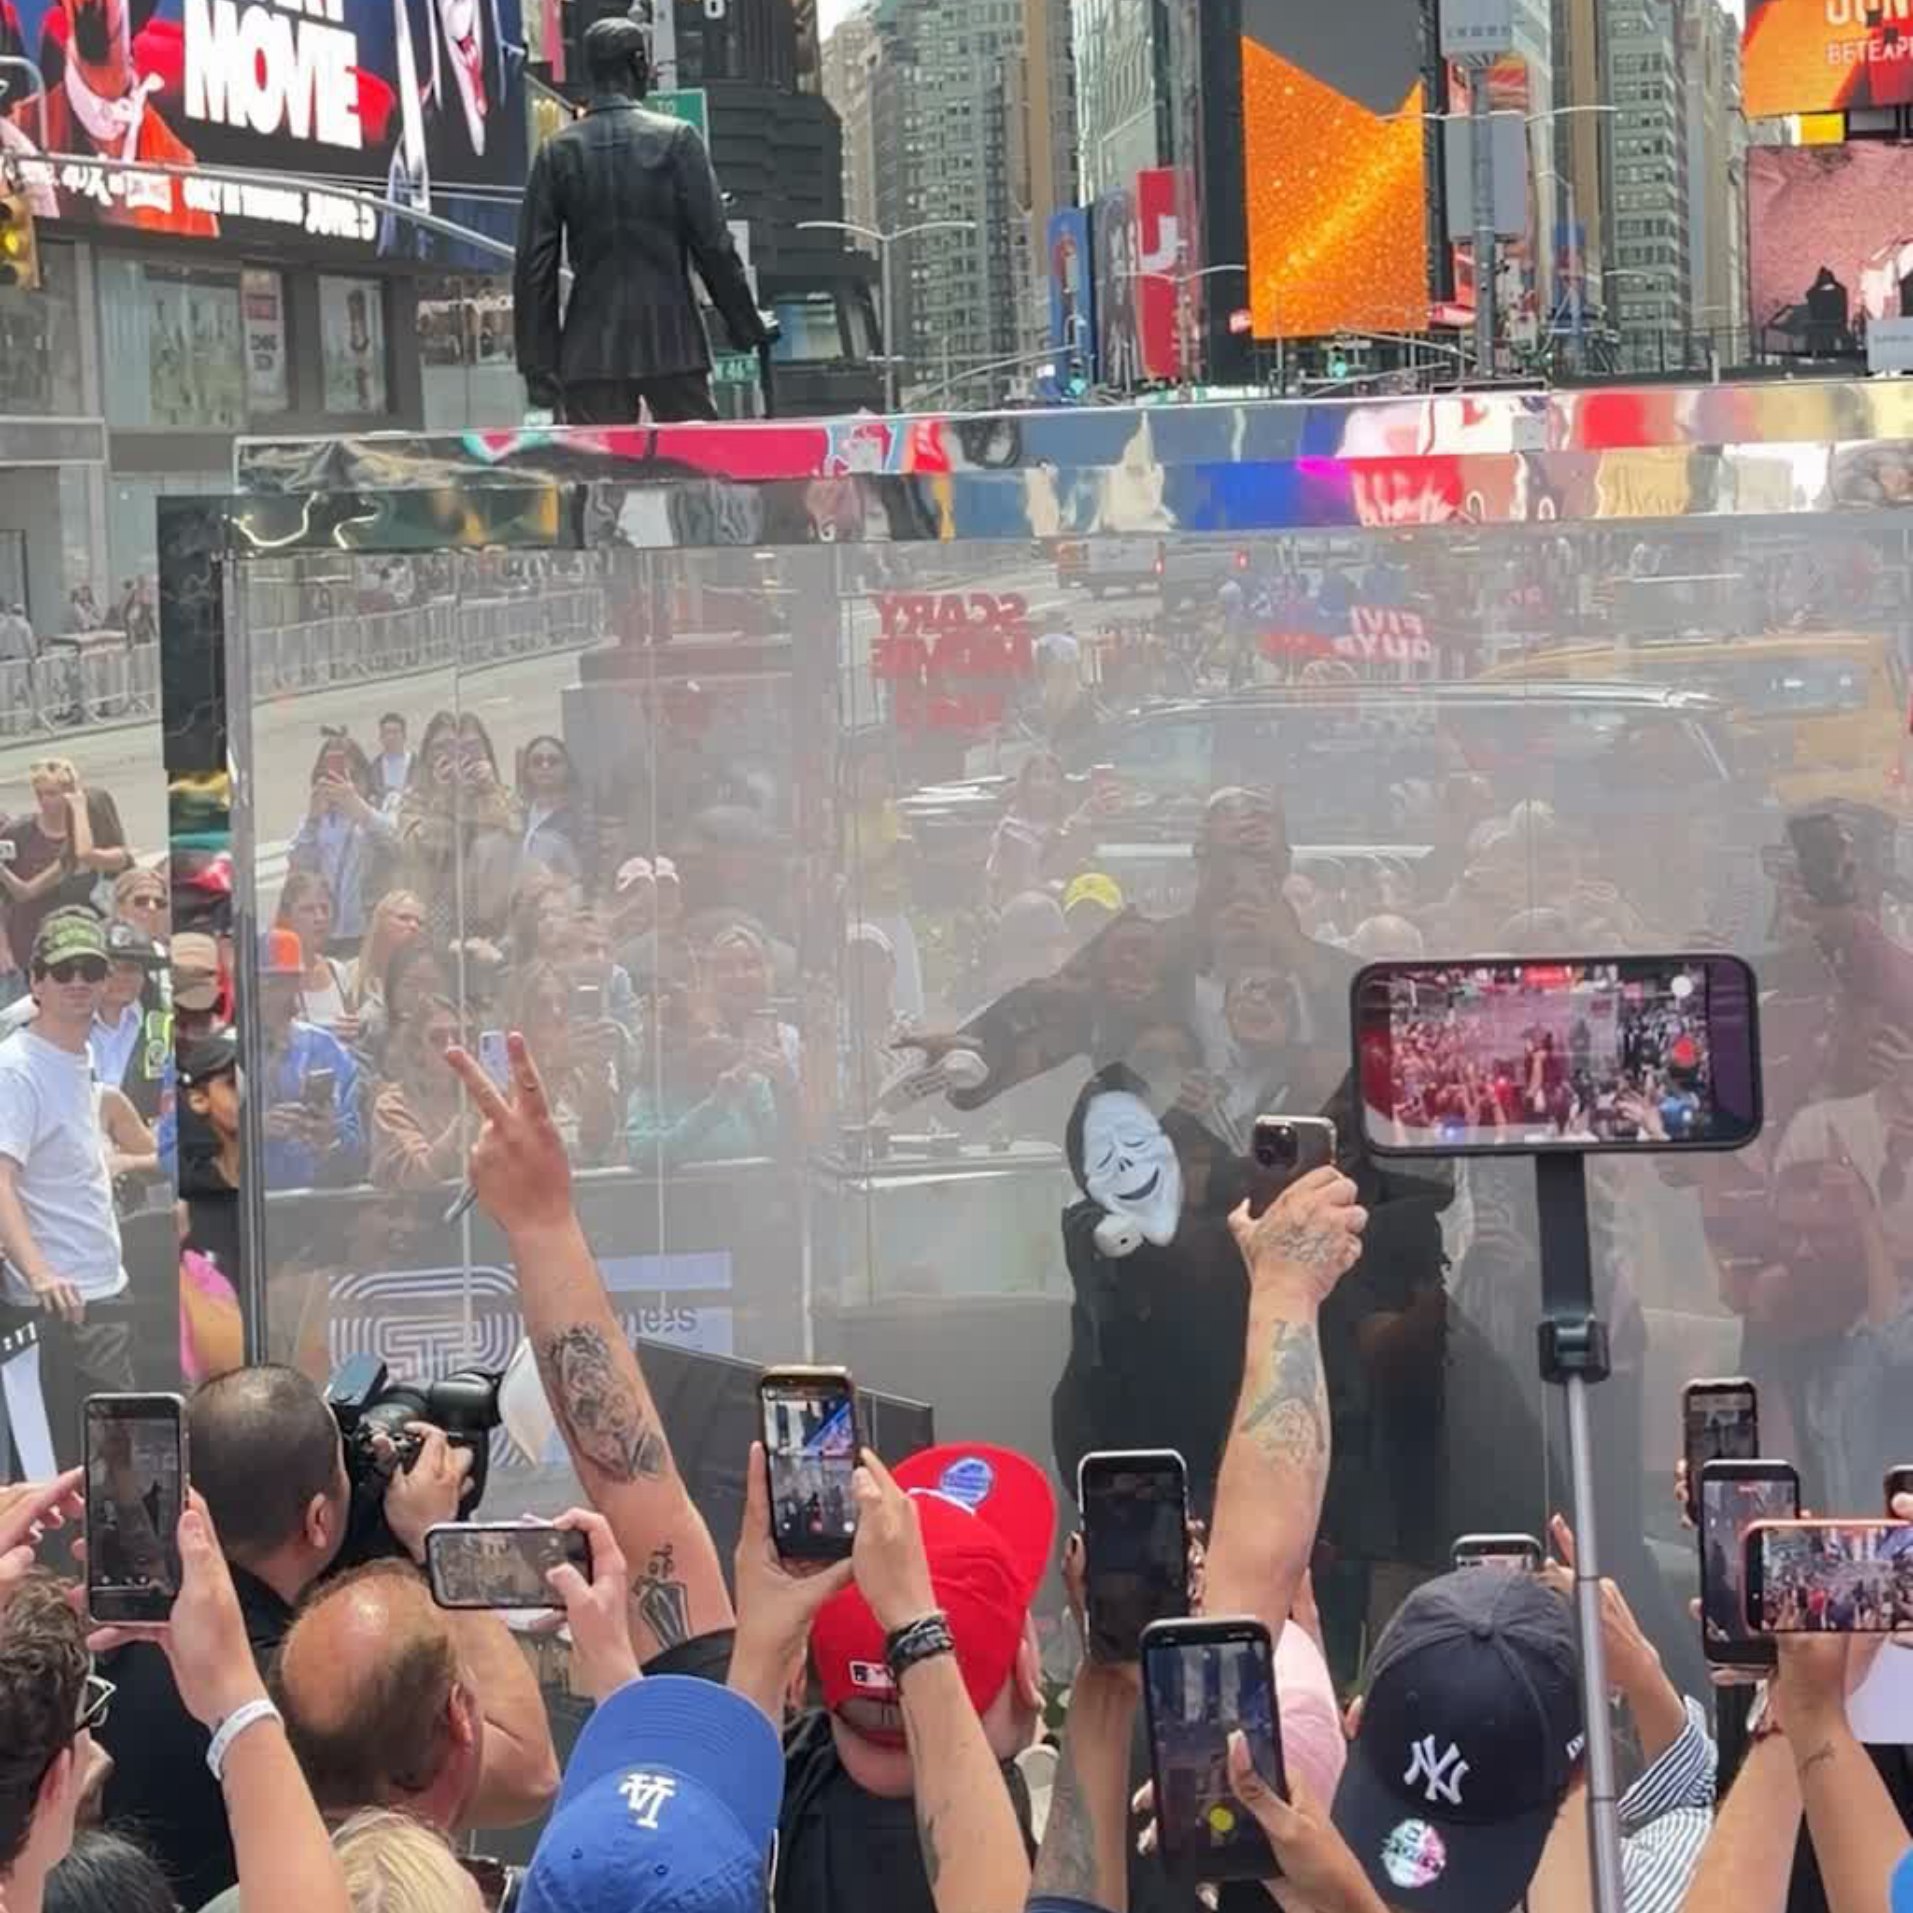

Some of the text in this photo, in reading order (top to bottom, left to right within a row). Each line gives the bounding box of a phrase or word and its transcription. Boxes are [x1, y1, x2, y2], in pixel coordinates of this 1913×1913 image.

[184, 0, 362, 150] MOVIE
[618, 1772, 676, 1830] LA
[1403, 1733, 1470, 1805] NY
